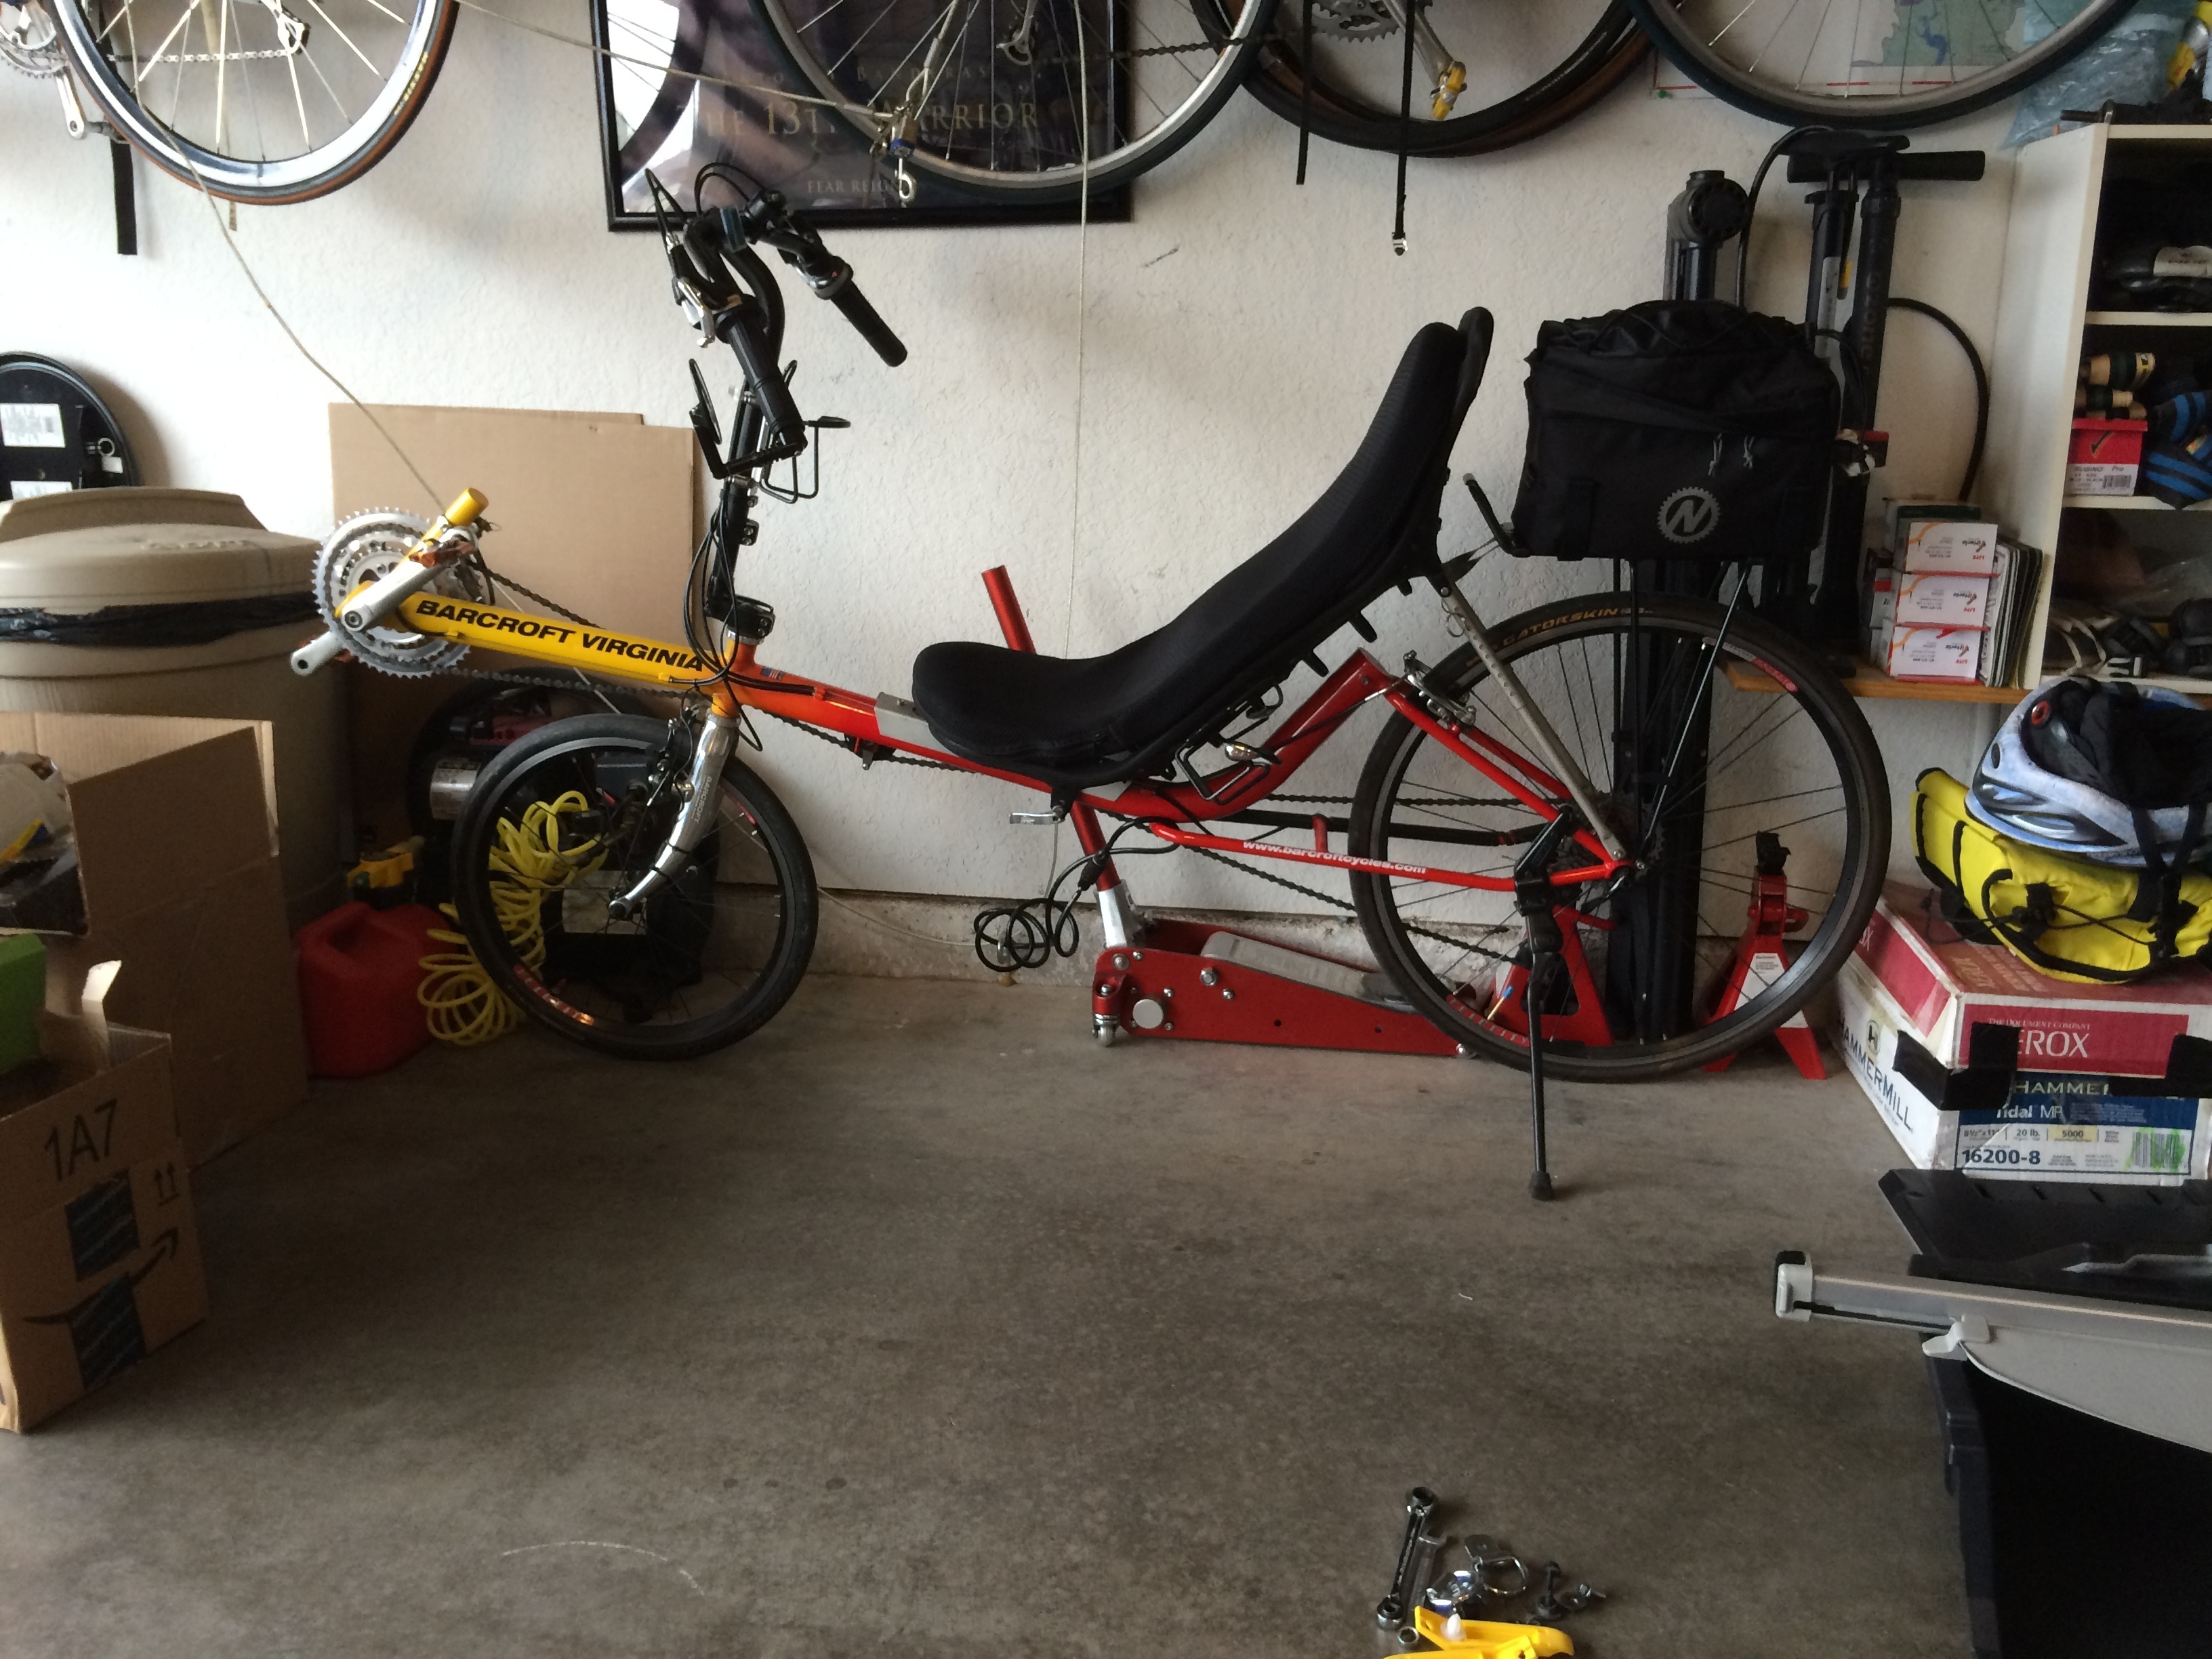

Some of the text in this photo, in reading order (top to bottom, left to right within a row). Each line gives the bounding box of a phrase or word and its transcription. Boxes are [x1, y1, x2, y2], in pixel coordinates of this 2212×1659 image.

[415, 600, 706, 673] BARCROFT VIRGINIA
[1242, 840, 1427, 874] www.barcroftcycles.com
[2018, 1029, 2090, 1059] ROX
[1839, 1019, 1912, 1132] AMMERMILL
[44, 1097, 118, 1181] 1A7
[2062, 1130, 2085, 1139] 5000
[1961, 1149, 2042, 1166] 16200-8
